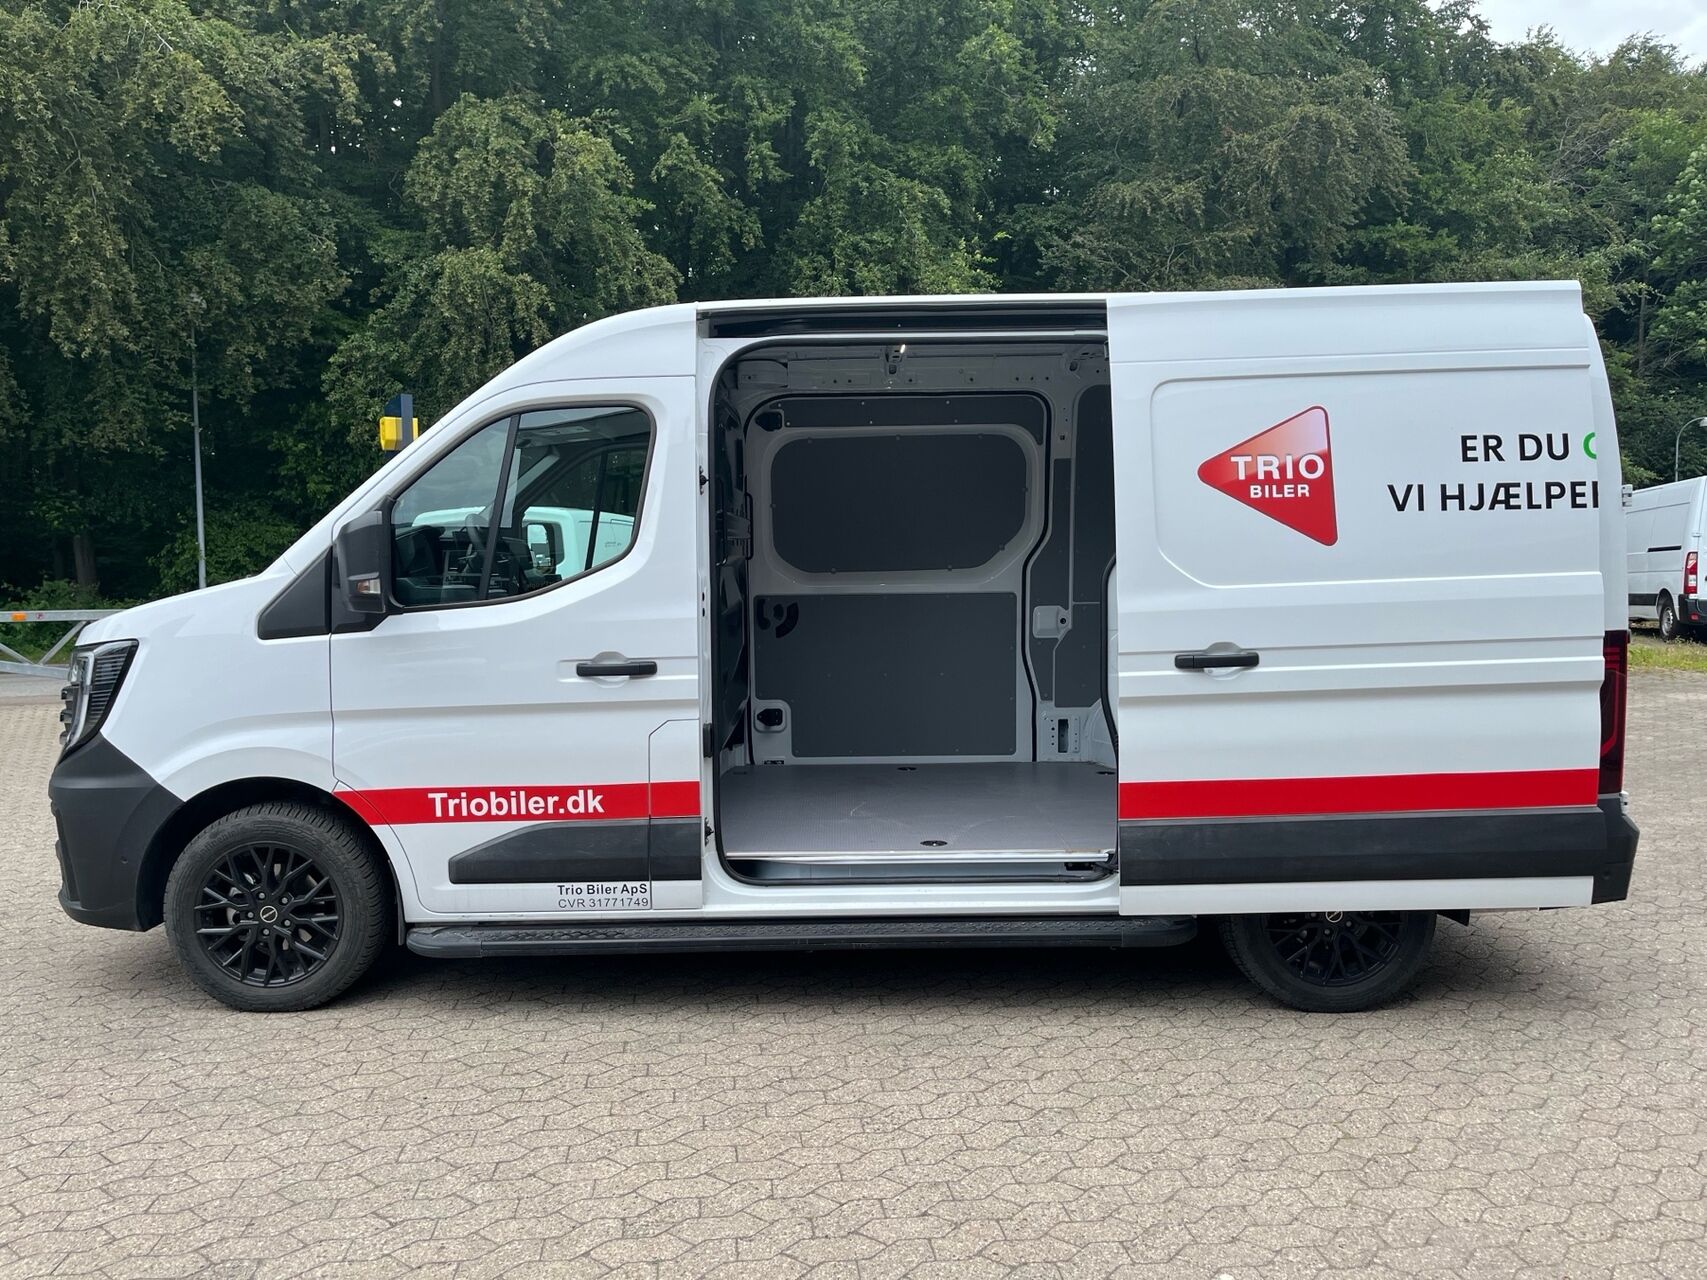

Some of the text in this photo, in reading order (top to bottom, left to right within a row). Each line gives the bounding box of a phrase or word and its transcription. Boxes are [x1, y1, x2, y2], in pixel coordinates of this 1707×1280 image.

[1460, 434, 1505, 462] ER
[1518, 432, 1570, 461] DU
[1230, 453, 1325, 480] TRIO
[1249, 484, 1310, 498] BILER
[1387, 484, 1424, 511] VI
[427, 789, 606, 817] Triobiler.dk
[557, 883, 648, 896] Trio Biler ApS
[558, 897, 649, 909] CVR 31771749
